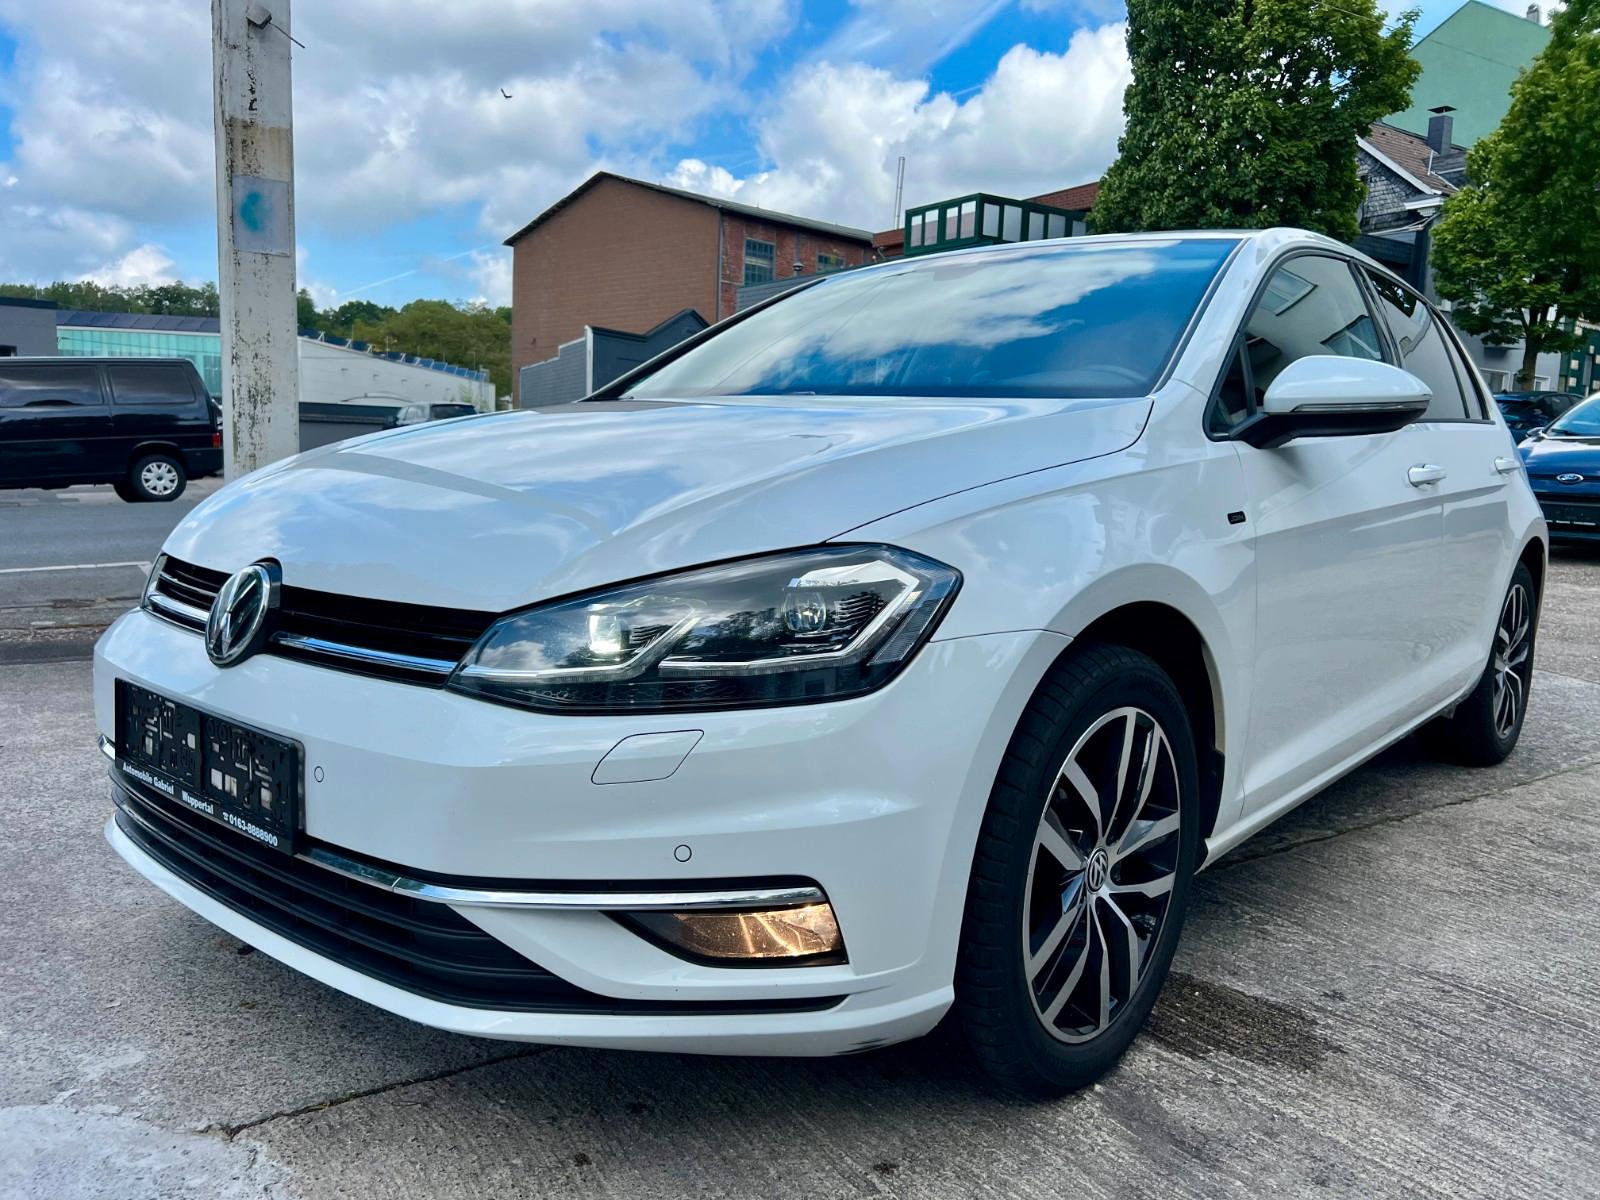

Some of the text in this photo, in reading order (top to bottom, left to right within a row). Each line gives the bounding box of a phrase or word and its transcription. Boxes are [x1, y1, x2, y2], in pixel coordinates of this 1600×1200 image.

[123, 761, 278, 847] Automobile Gabriel Wuppertal 0163-8888900
